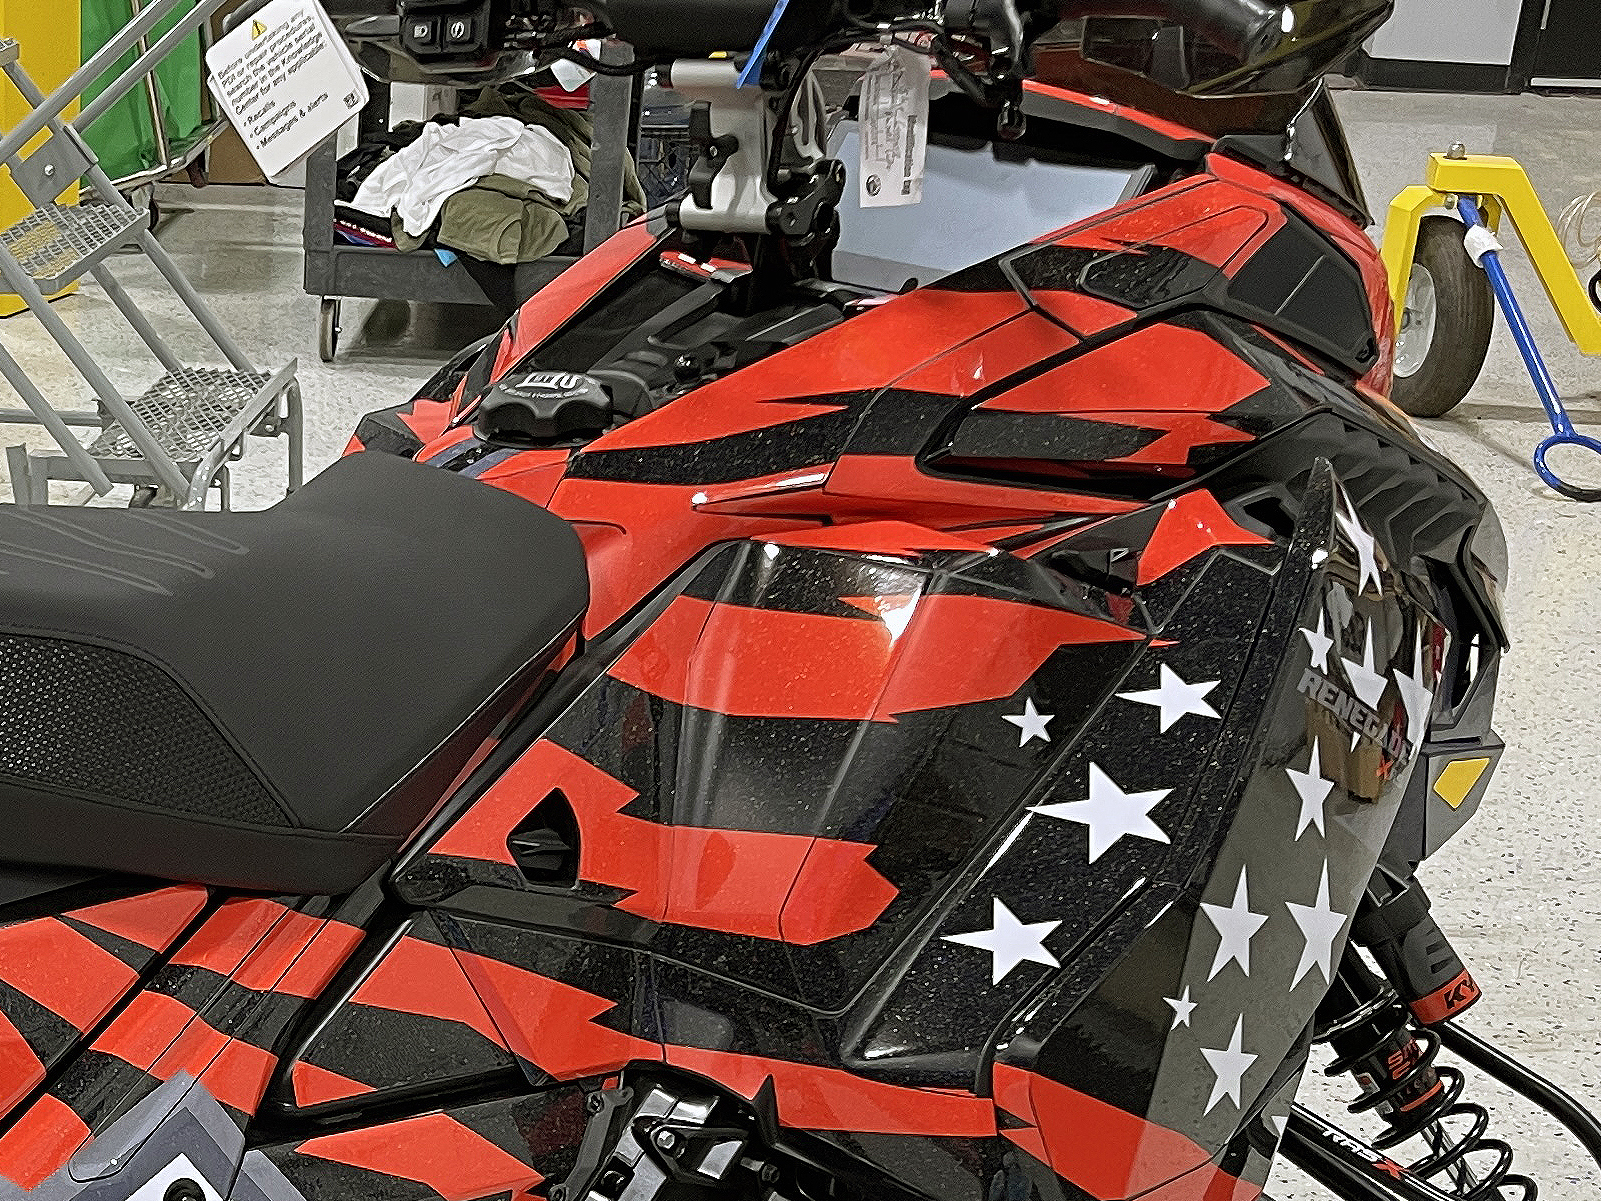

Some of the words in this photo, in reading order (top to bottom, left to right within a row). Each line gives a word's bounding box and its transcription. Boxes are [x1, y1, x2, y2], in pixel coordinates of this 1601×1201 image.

[246, 100, 275, 124] Recalls
[253, 100, 297, 137] Campaigns
[259, 115, 299, 149] Messages
